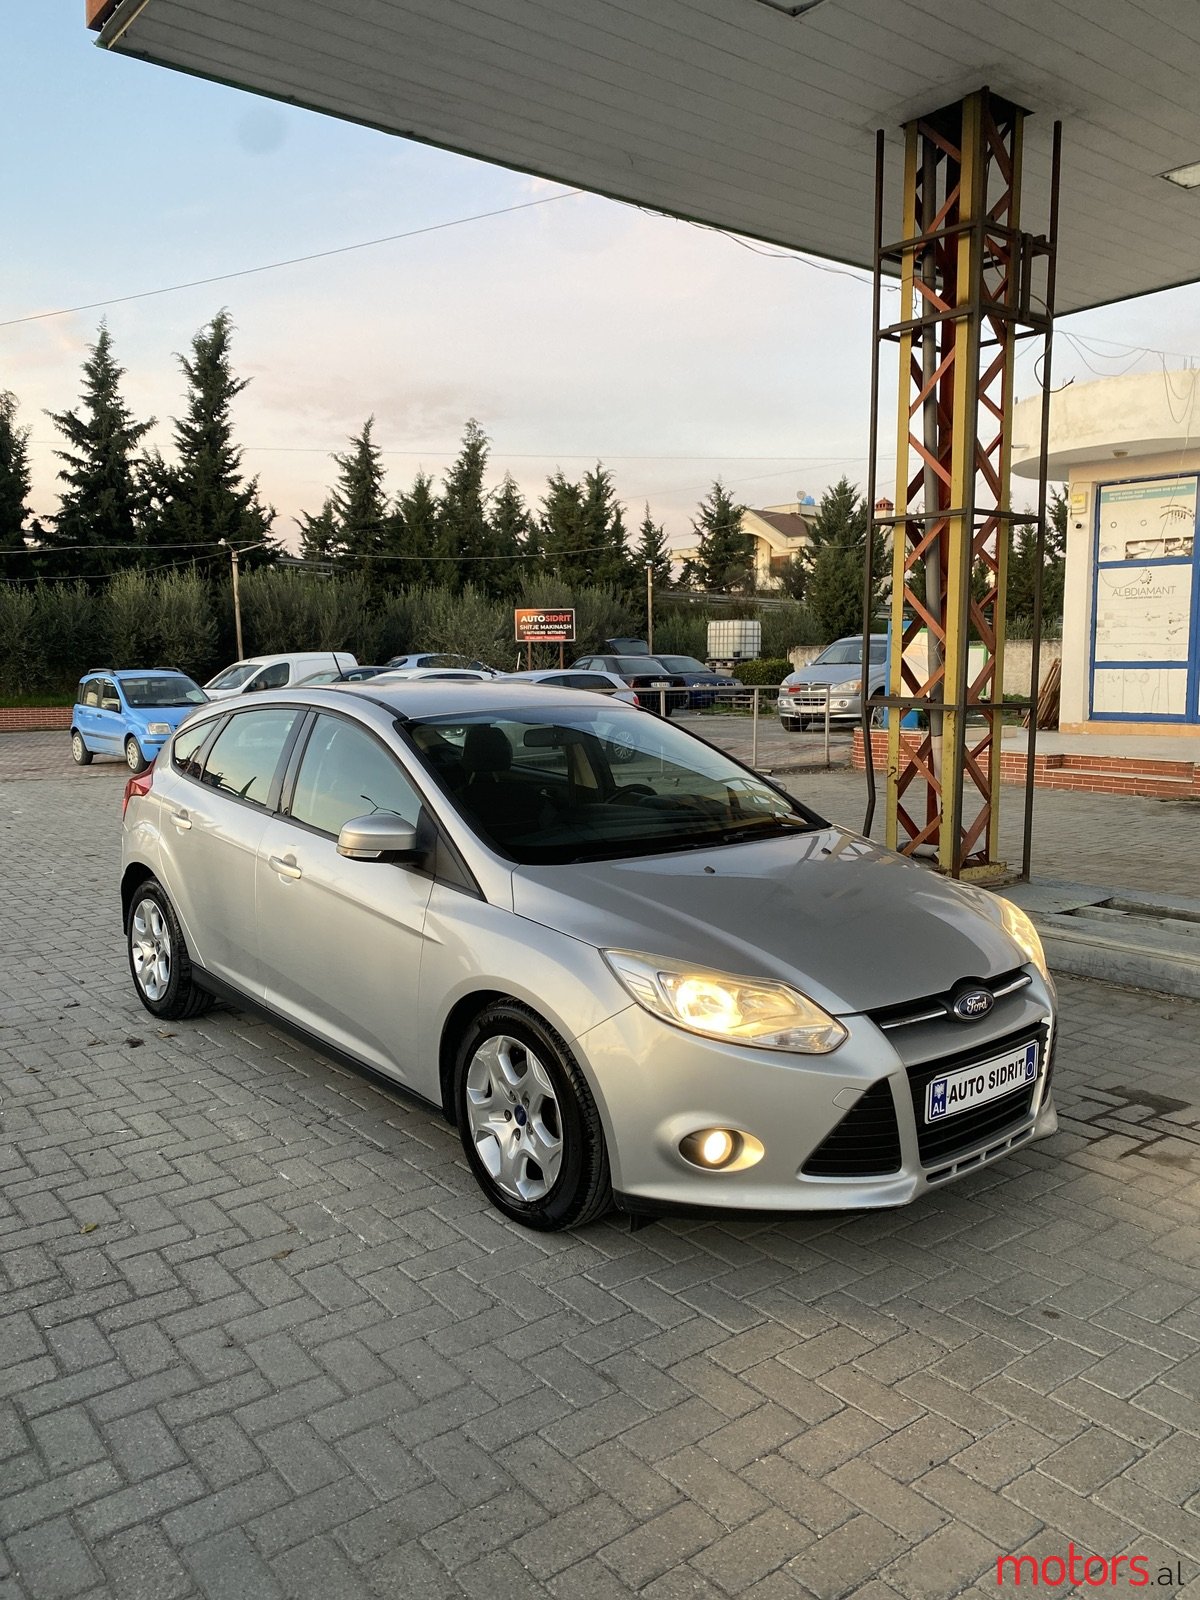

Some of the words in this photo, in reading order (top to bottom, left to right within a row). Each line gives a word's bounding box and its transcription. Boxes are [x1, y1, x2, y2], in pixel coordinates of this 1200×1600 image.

[1112, 585, 1177, 597] ALBDIAMANT
[966, 995, 988, 1014] Ford
[948, 1075, 985, 1104] AUTO
[988, 1057, 1025, 1090] SIDRIT
[932, 1102, 945, 1115] AL
